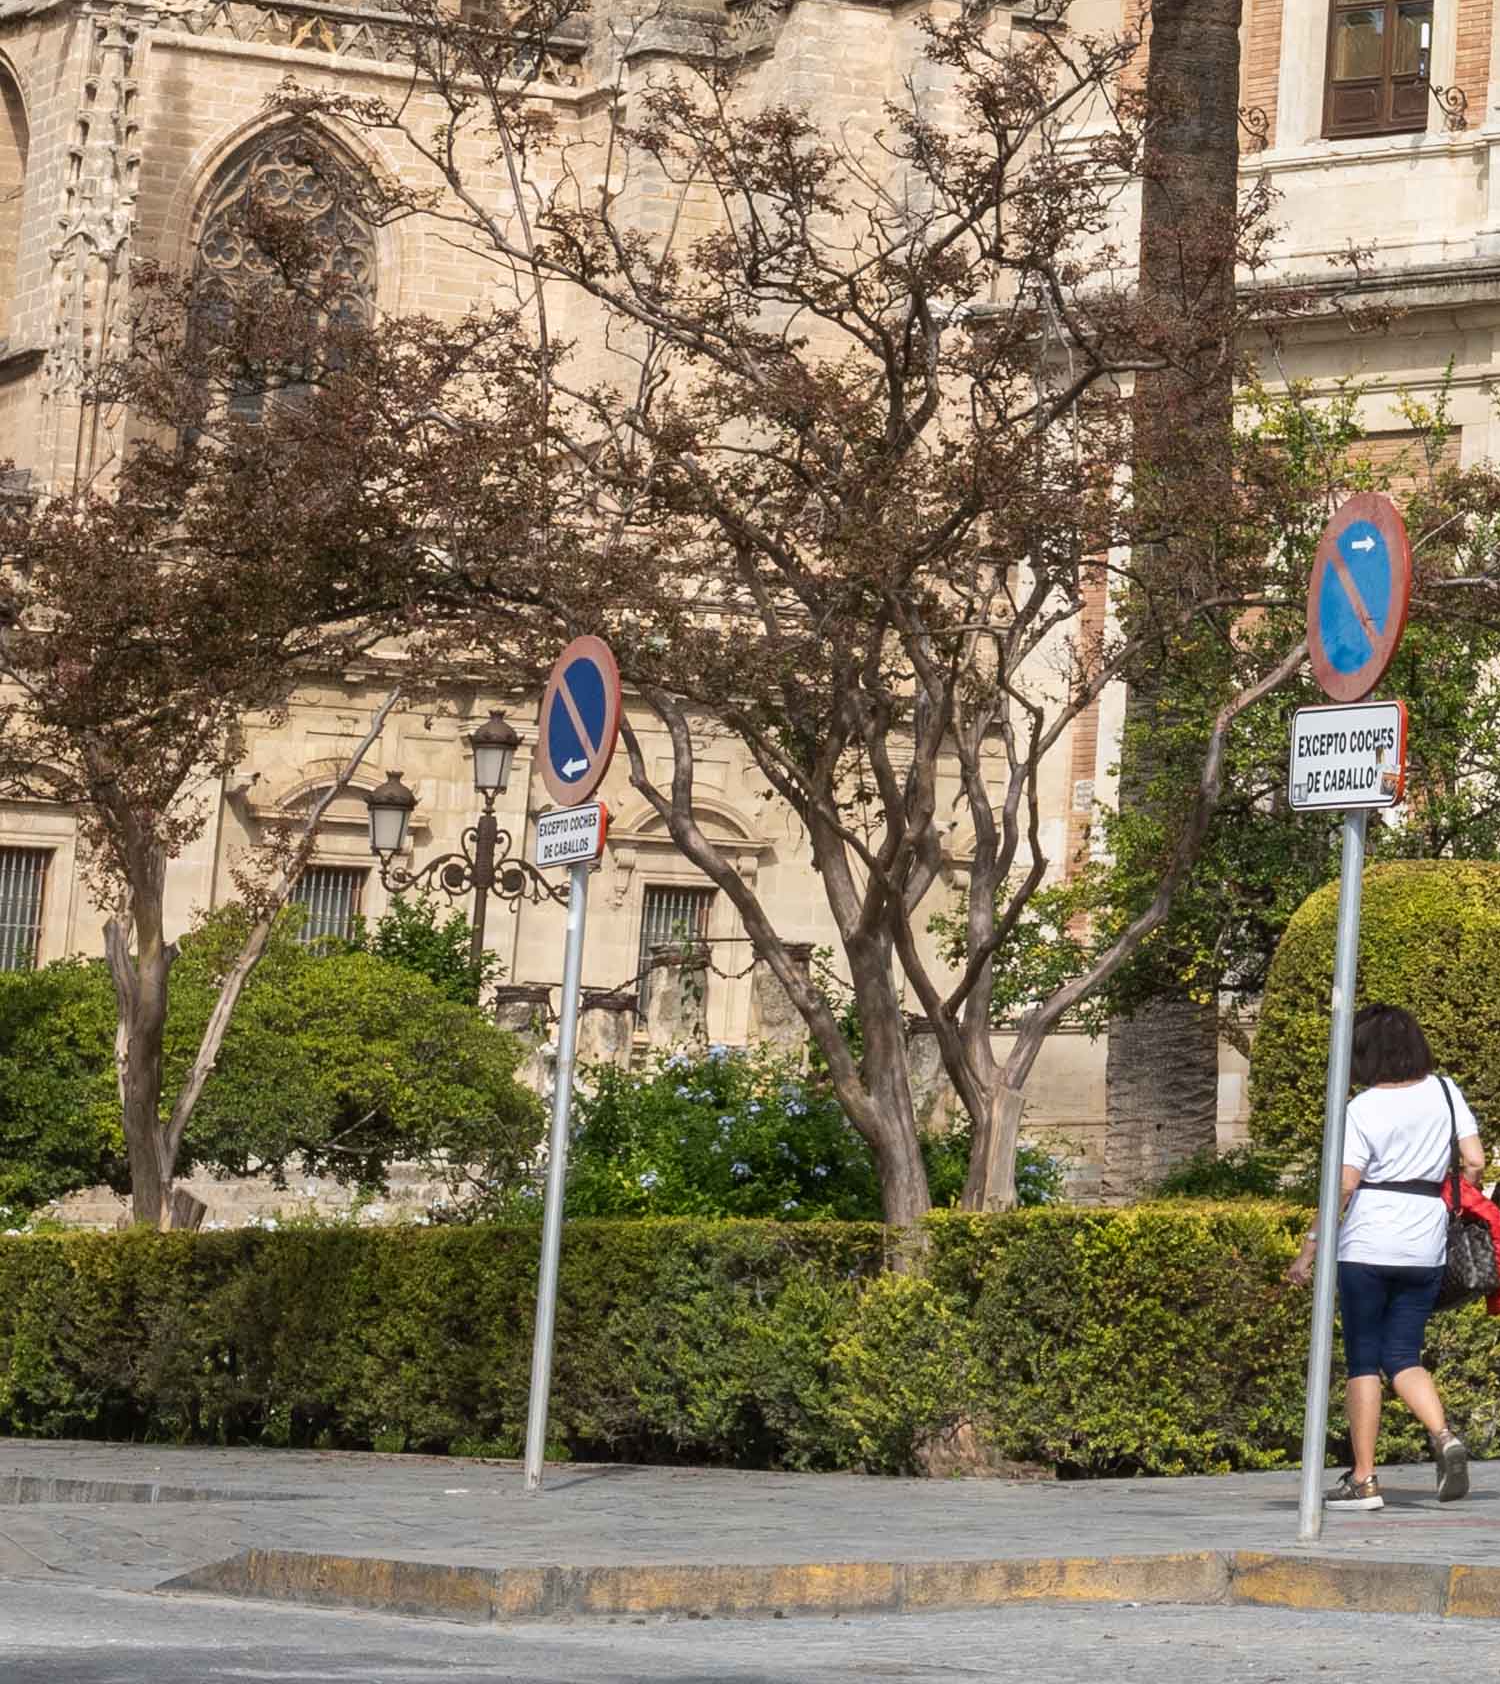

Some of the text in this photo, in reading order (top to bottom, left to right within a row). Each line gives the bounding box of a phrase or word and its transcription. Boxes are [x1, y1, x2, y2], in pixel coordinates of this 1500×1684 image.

[1298, 727, 1394, 758] EXCEPTO COCHES
[1307, 772, 1320, 793] DE
[540, 812, 597, 837] EXCEPTO COCHES
[544, 837, 589, 859] DE CABALLOS
